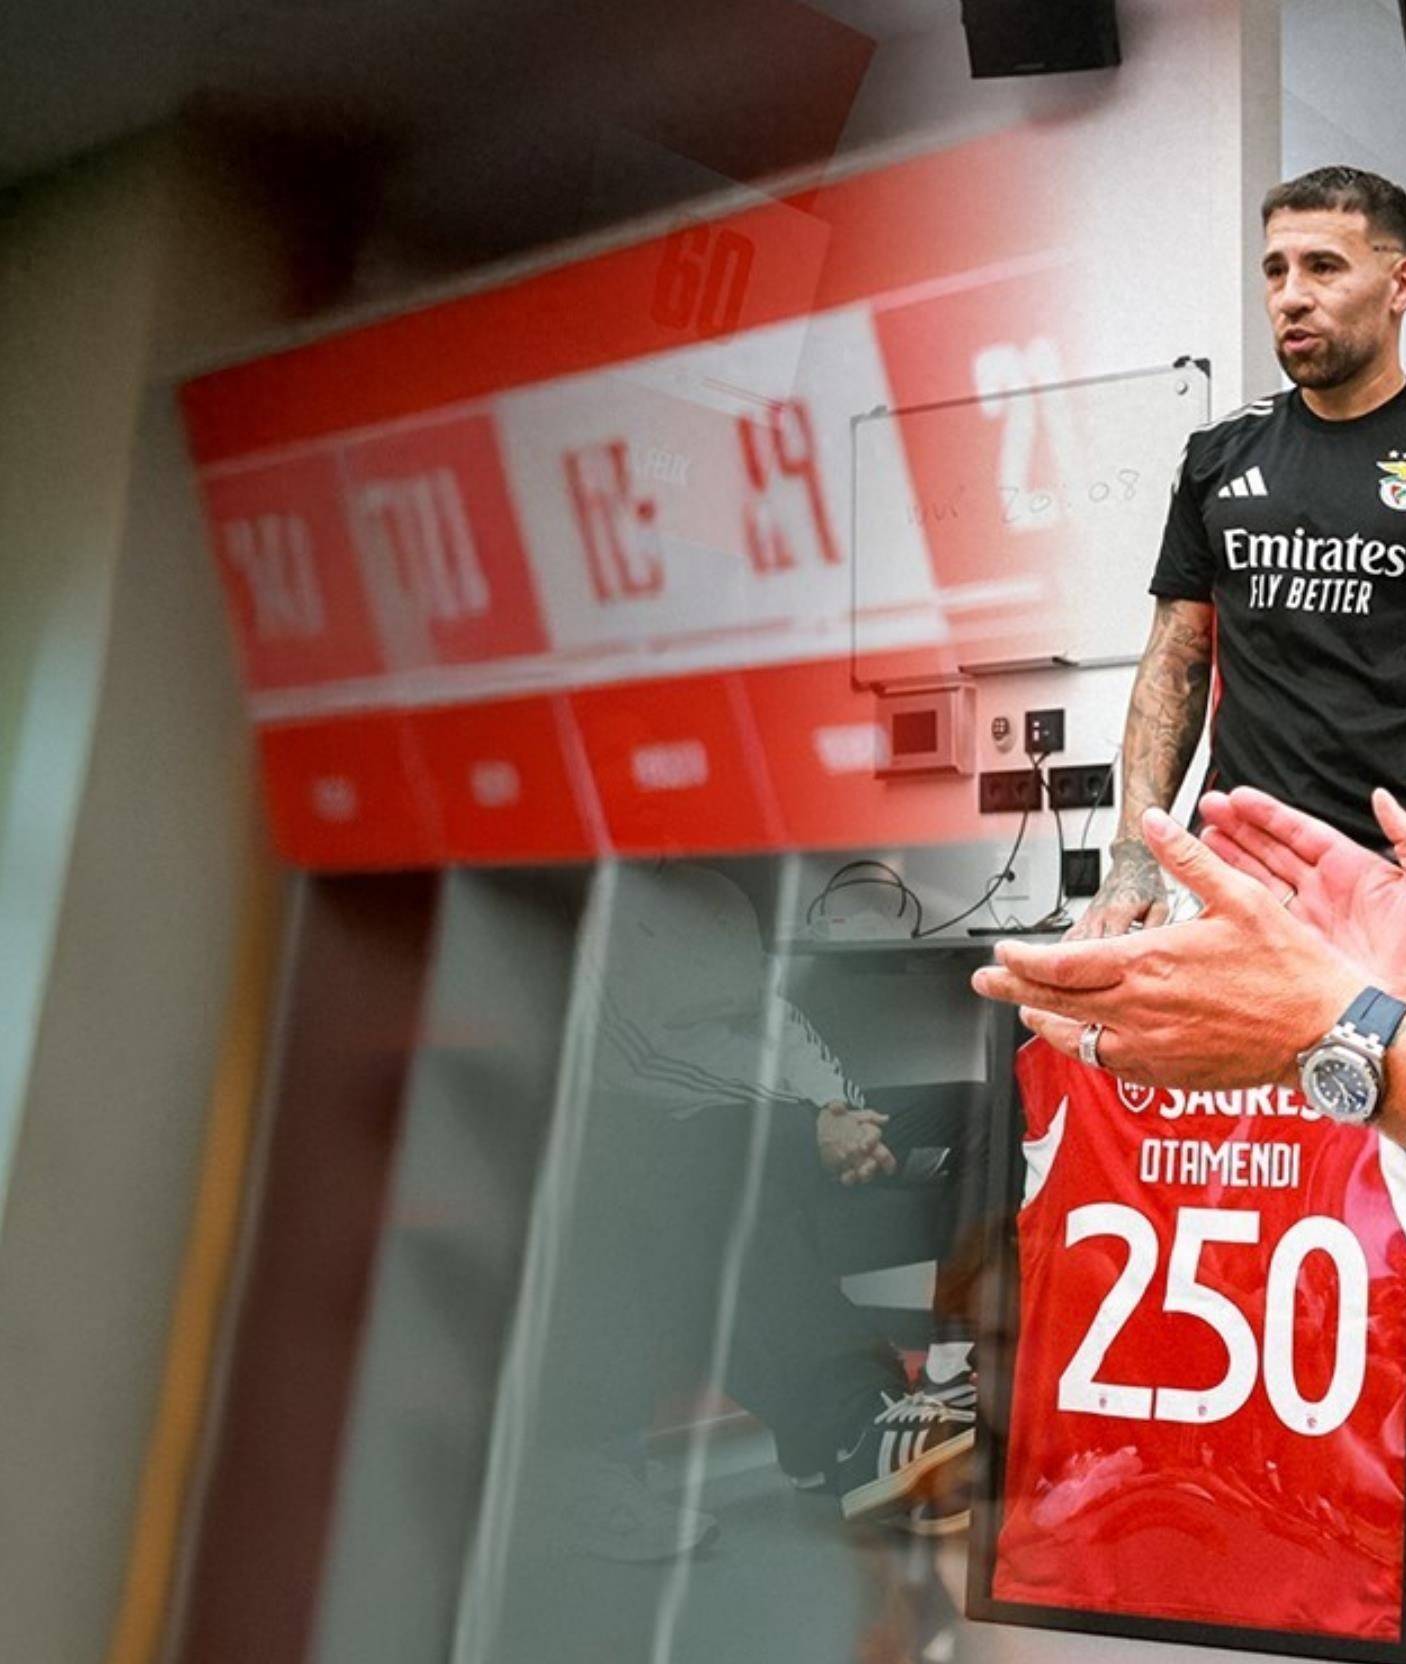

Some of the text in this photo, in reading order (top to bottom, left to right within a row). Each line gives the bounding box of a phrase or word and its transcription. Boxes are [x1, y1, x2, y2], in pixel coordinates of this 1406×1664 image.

[1223, 526, 1406, 578] Emirates
[1249, 573, 1373, 615] FLY BETTER
[1139, 1137, 1301, 1189] OTAMENDI
[1057, 1201, 1370, 1437] 250
